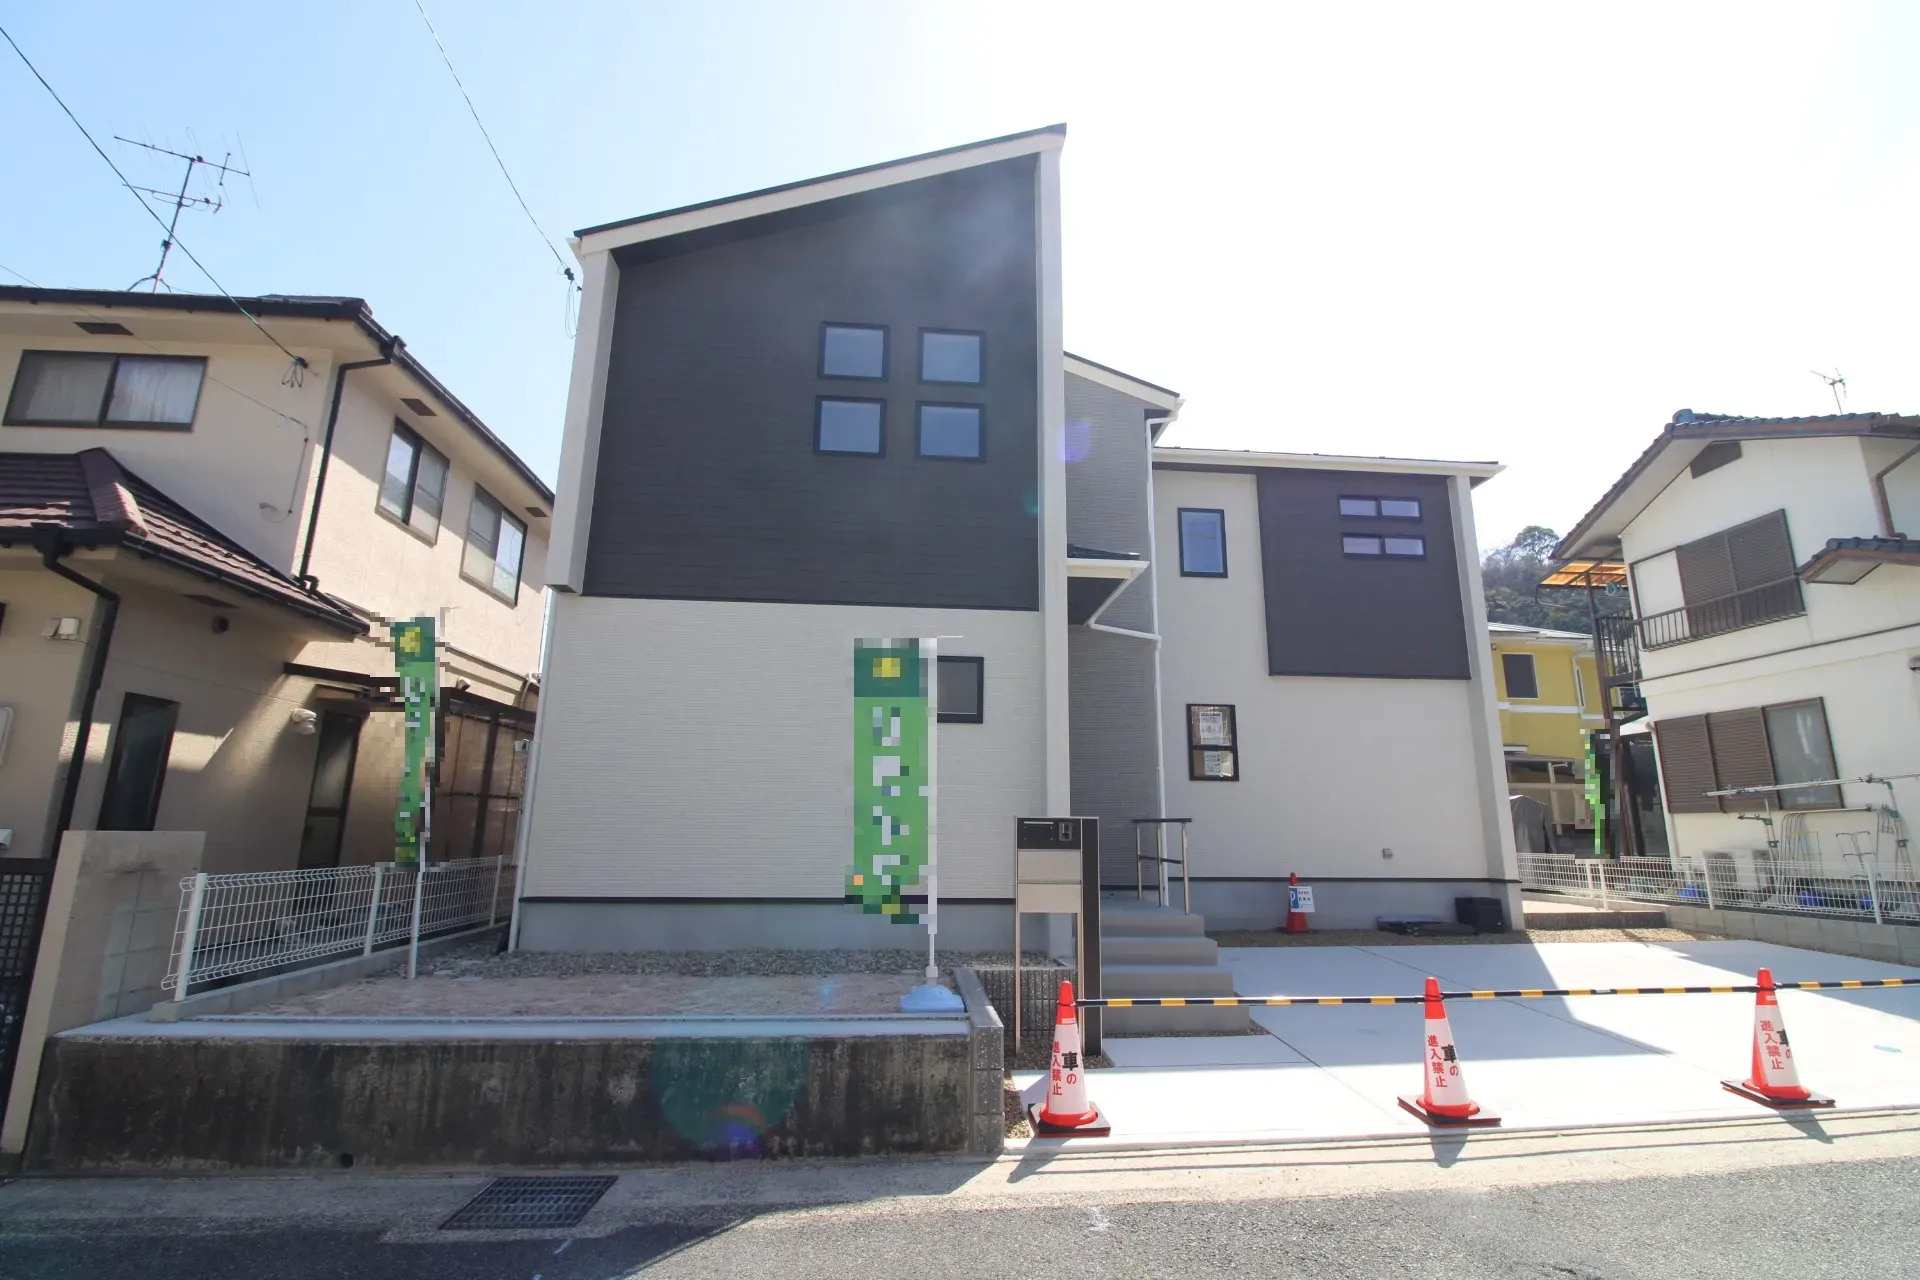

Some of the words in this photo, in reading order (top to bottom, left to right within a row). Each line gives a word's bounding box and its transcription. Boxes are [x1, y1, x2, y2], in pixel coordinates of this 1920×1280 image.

[1052, 1040, 1062, 1096] 進入禁止
[1061, 1051, 1079, 1085] 車の
[1427, 1034, 1448, 1088] 進入禁止
[1441, 1044, 1459, 1077] 車の
[1760, 1019, 1785, 1070] 進入禁止
